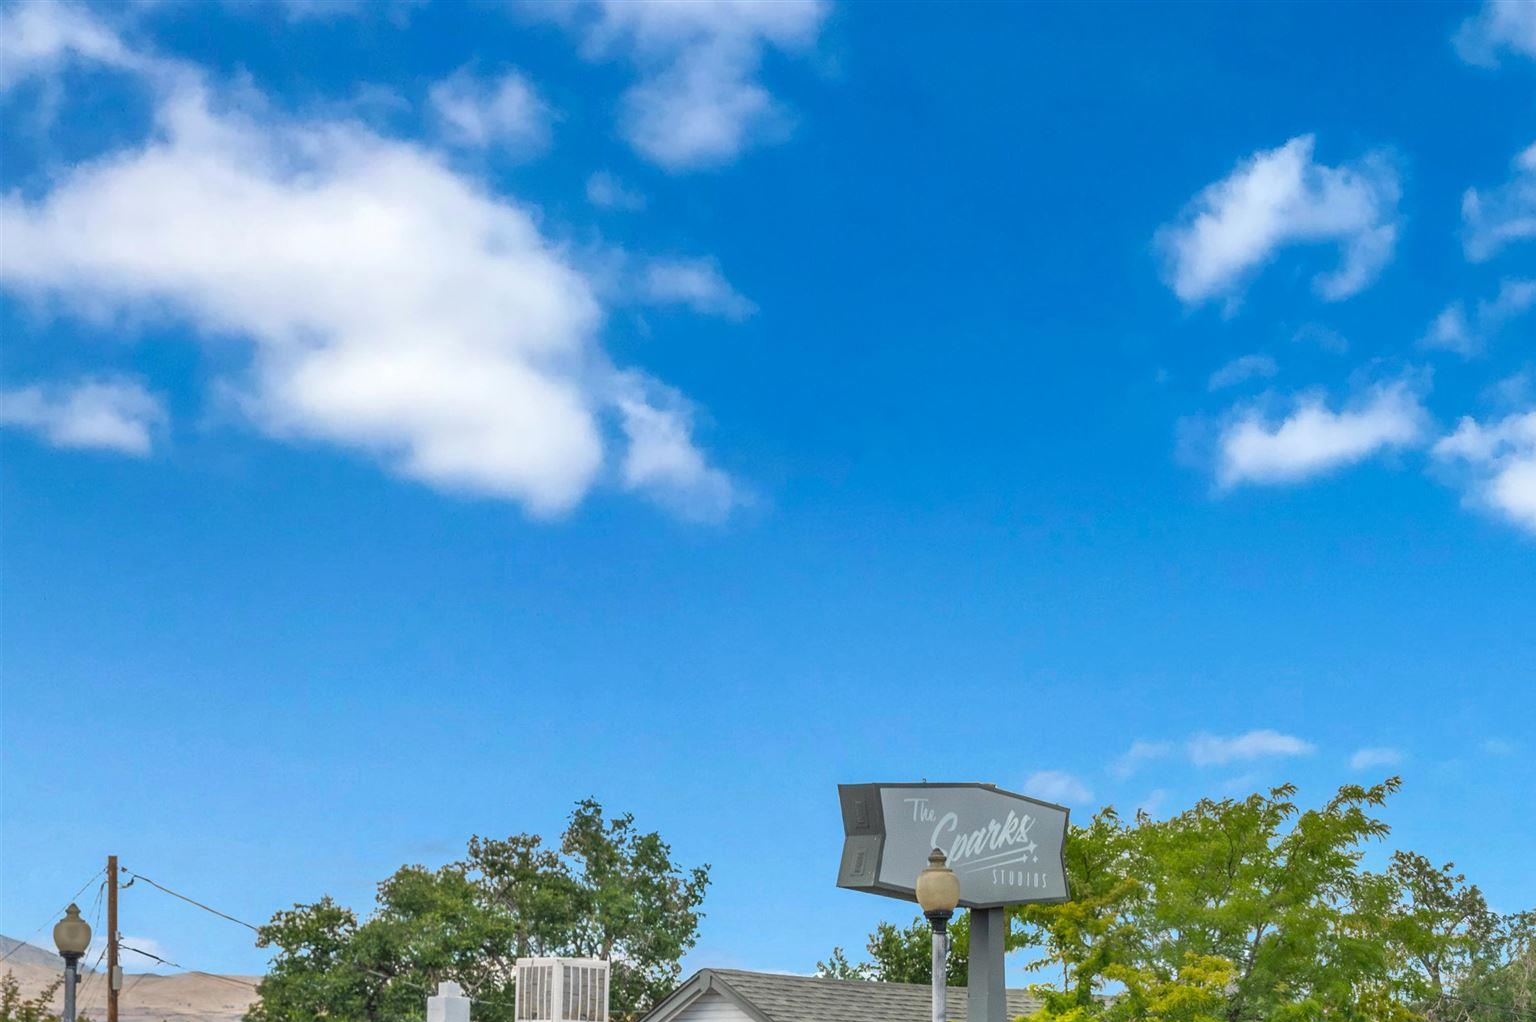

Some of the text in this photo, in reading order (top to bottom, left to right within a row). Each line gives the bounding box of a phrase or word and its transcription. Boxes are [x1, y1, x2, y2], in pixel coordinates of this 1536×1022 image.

[903, 798, 936, 822] The
[930, 810, 1036, 866] Sparks
[992, 869, 1047, 889] STUDIOS
